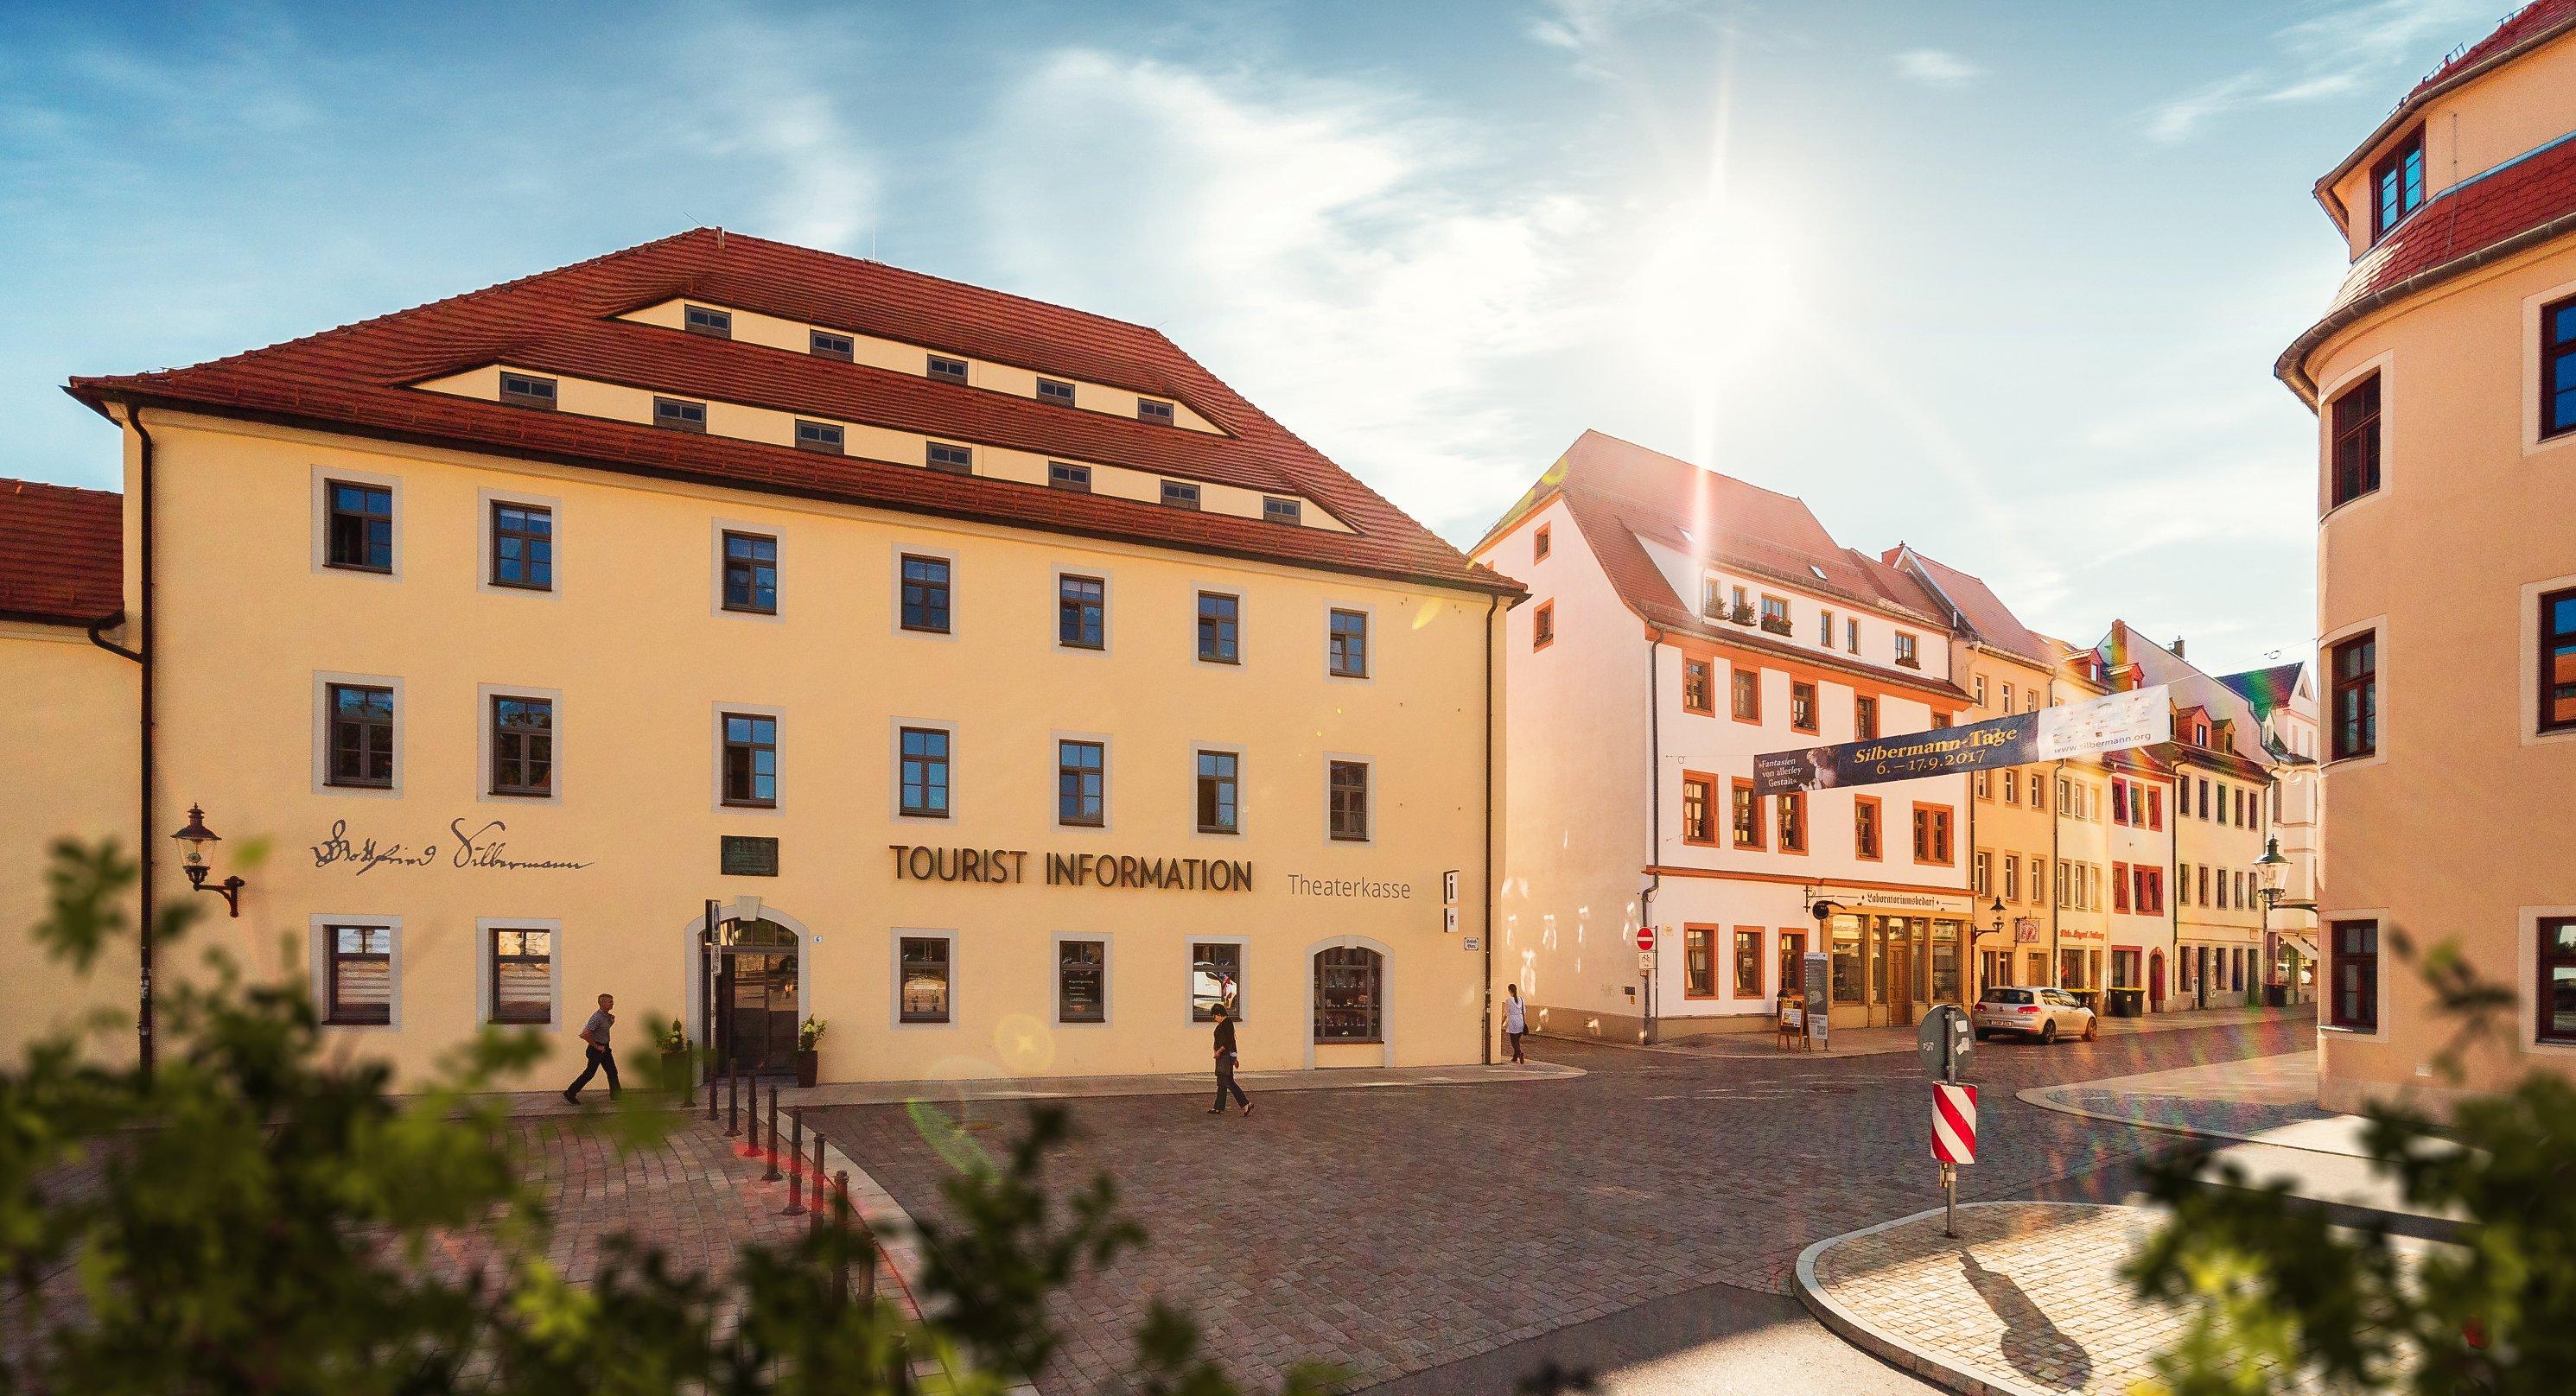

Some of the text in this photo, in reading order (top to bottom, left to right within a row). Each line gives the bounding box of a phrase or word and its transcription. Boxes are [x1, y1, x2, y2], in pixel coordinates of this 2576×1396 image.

[1854, 727, 2018, 764] Silbermann-Tage
[2053, 733, 2152, 754] www.silbermann.org
[1777, 766, 1803, 776] allerley
[1877, 762, 1891, 775] 6.
[450, 818, 595, 869] Silbermann
[889, 845, 1253, 892] TOURIST INFORMATION
[1287, 873, 1411, 899] Theaterkasse
[1867, 892, 1935, 907] Laboratoriumsbedarf
